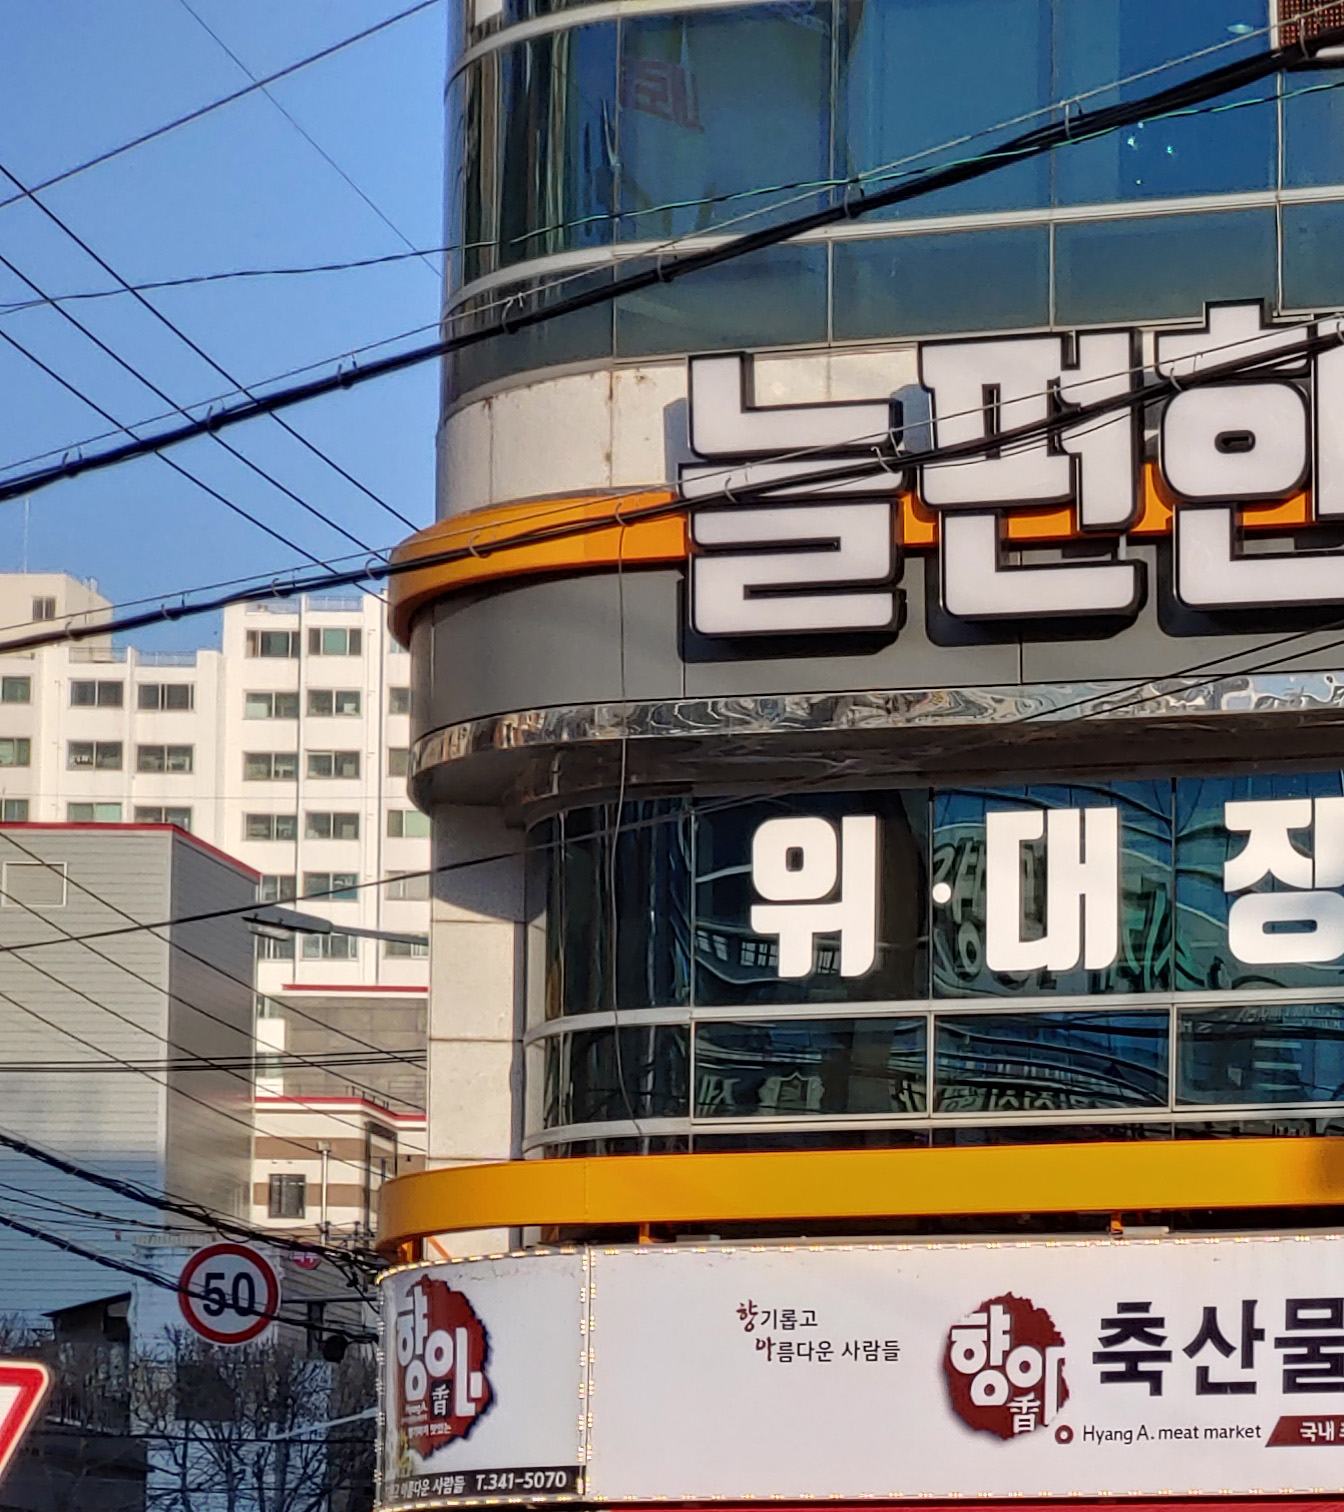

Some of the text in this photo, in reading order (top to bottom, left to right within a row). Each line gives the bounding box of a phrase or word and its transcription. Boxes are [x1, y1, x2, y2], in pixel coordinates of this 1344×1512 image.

[203, 1271, 256, 1317] 50
[736, 1299, 818, 1332] 향기롭고
[755, 1336, 900, 1364] 아름다운 사람들
[1083, 1425, 1132, 1445] Hyang
[1158, 1427, 1200, 1441] meat
[1204, 1423, 1262, 1441] market
[1300, 1421, 1335, 1443] 국내
[432, 1475, 466, 1496] 사람들
[476, 1471, 568, 1492] T.341-5070
